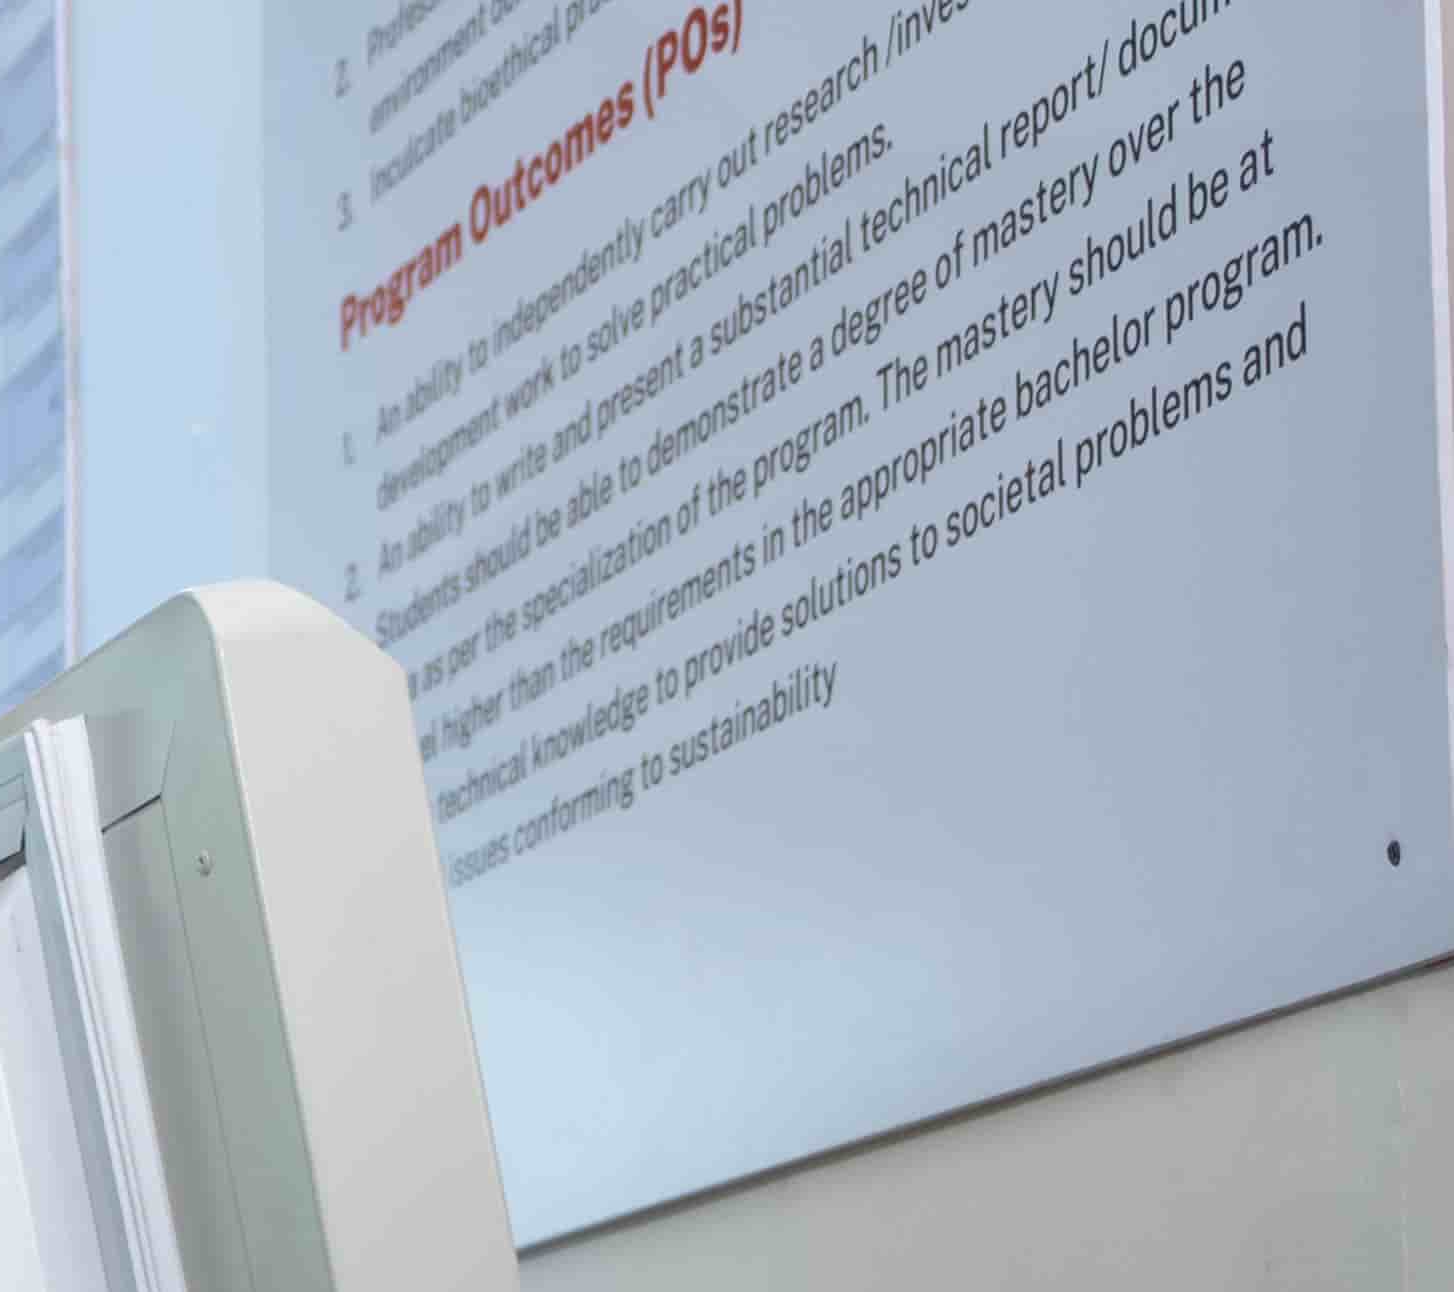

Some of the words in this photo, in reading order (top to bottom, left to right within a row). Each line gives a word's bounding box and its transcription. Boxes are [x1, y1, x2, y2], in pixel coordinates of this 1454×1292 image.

[340, 224, 463, 352] Program
[469, 83, 634, 242] Outcomes
[643, 0, 743, 118] (POs)
[376, 404, 402, 441] An
[405, 358, 463, 422] ability
[467, 337, 489, 374] to
[493, 221, 645, 352] independently
[651, 168, 711, 238] carry
[717, 129, 758, 189] out
[764, 39, 878, 152] research
[460, 9, 561, 124] bioethical
[374, 575, 462, 651] Students
[464, 518, 532, 592] should
[535, 507, 562, 548] be
[567, 473, 614, 529] able
[618, 455, 642, 493] to
[647, 351, 803, 475] demonstrate
[809, 335, 825, 372] a
[831, 269, 927, 356] degree
[935, 230, 965, 290] of
[973, 155, 1099, 265] mastery
[1108, 100, 1180, 177] over
[1189, 59, 1245, 124] the
[377, 399, 500, 510] development
[504, 360, 554, 418] work
[559, 343, 582, 381] to
[587, 298, 645, 362] solve
[650, 207, 756, 324] practical
[763, 124, 892, 245] problems.
[378, 541, 404, 575] An
[405, 500, 465, 561] ability
[470, 480, 491, 517] to
[495, 443, 548, 498] write
[551, 401, 593, 463] and
[597, 344, 684, 439] present
[690, 335, 704, 369] a
[711, 222, 853, 354] substantial
[861, 125, 991, 251] technical
[1000, 41, 1109, 157] report/
[421, 655, 445, 700] as
[447, 631, 481, 681] per
[484, 610, 517, 653] the
[522, 515, 672, 630] specialization
[676, 485, 701, 536] of
[707, 468, 747, 516] the
[753, 396, 870, 497] program.
[875, 355, 929, 409] The
[936, 273, 1059, 375] mastery
[1069, 184, 1177, 295] should
[1188, 168, 1229, 224] be
[1239, 129, 1274, 192] at
[441, 690, 504, 751] higher
[508, 661, 556, 710] than
[559, 637, 595, 681] the
[600, 544, 756, 653] requirements
[762, 524, 785, 565] in
[791, 498, 833, 548] the
[841, 397, 1007, 520] appropriate
[1015, 308, 1155, 417] bachelor
[1165, 215, 1323, 343] program.
[435, 743, 527, 825] technical
[531, 684, 649, 768] knowledge
[655, 667, 679, 705] to
[684, 610, 775, 695] provide
[781, 544, 902, 636] solutions
[909, 523, 939, 566] to
[946, 439, 1066, 546] societal
[1076, 362, 1232, 486] problems
[1243, 305, 1307, 386] and
[447, 833, 510, 887] issues
[513, 768, 635, 855] conforming
[640, 753, 664, 791] to
[669, 663, 836, 775] sustainability
